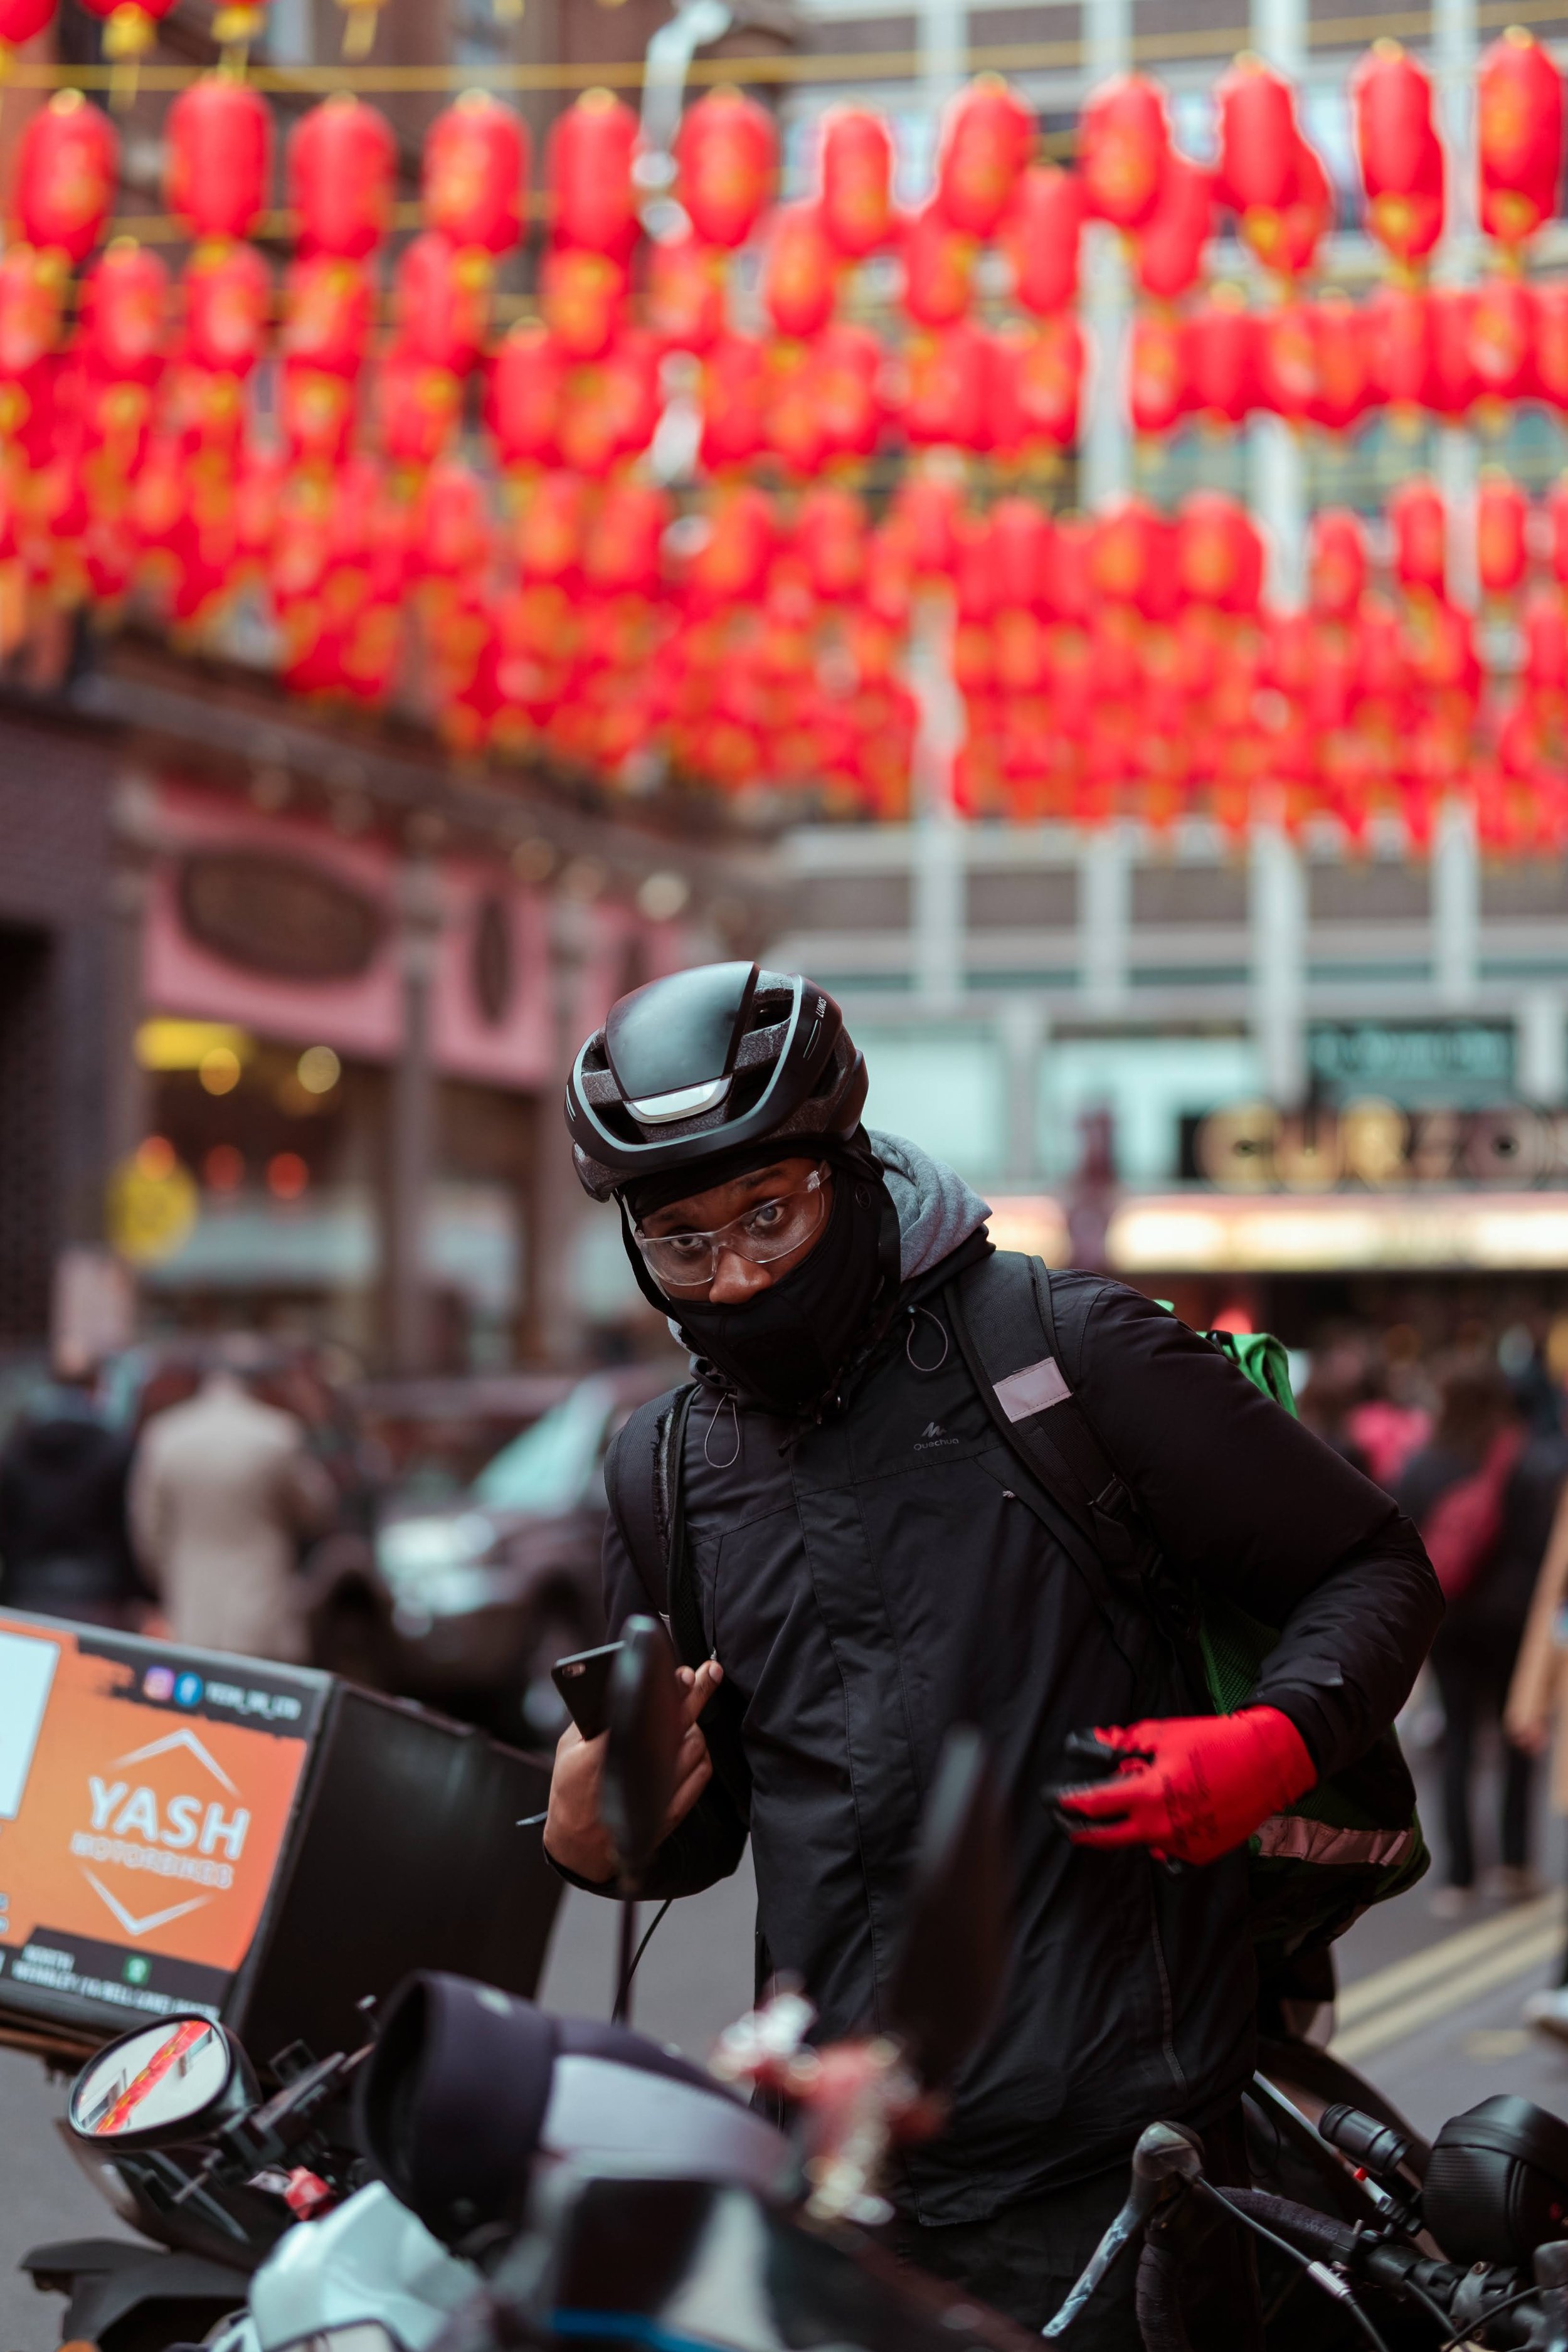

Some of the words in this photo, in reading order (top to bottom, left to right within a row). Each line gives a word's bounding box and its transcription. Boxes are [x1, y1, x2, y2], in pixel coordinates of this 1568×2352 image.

[815, 997, 827, 1018] LUMOS
[913, 1438, 959, 1451] Quechua
[88, 1776, 250, 1860] YASH
